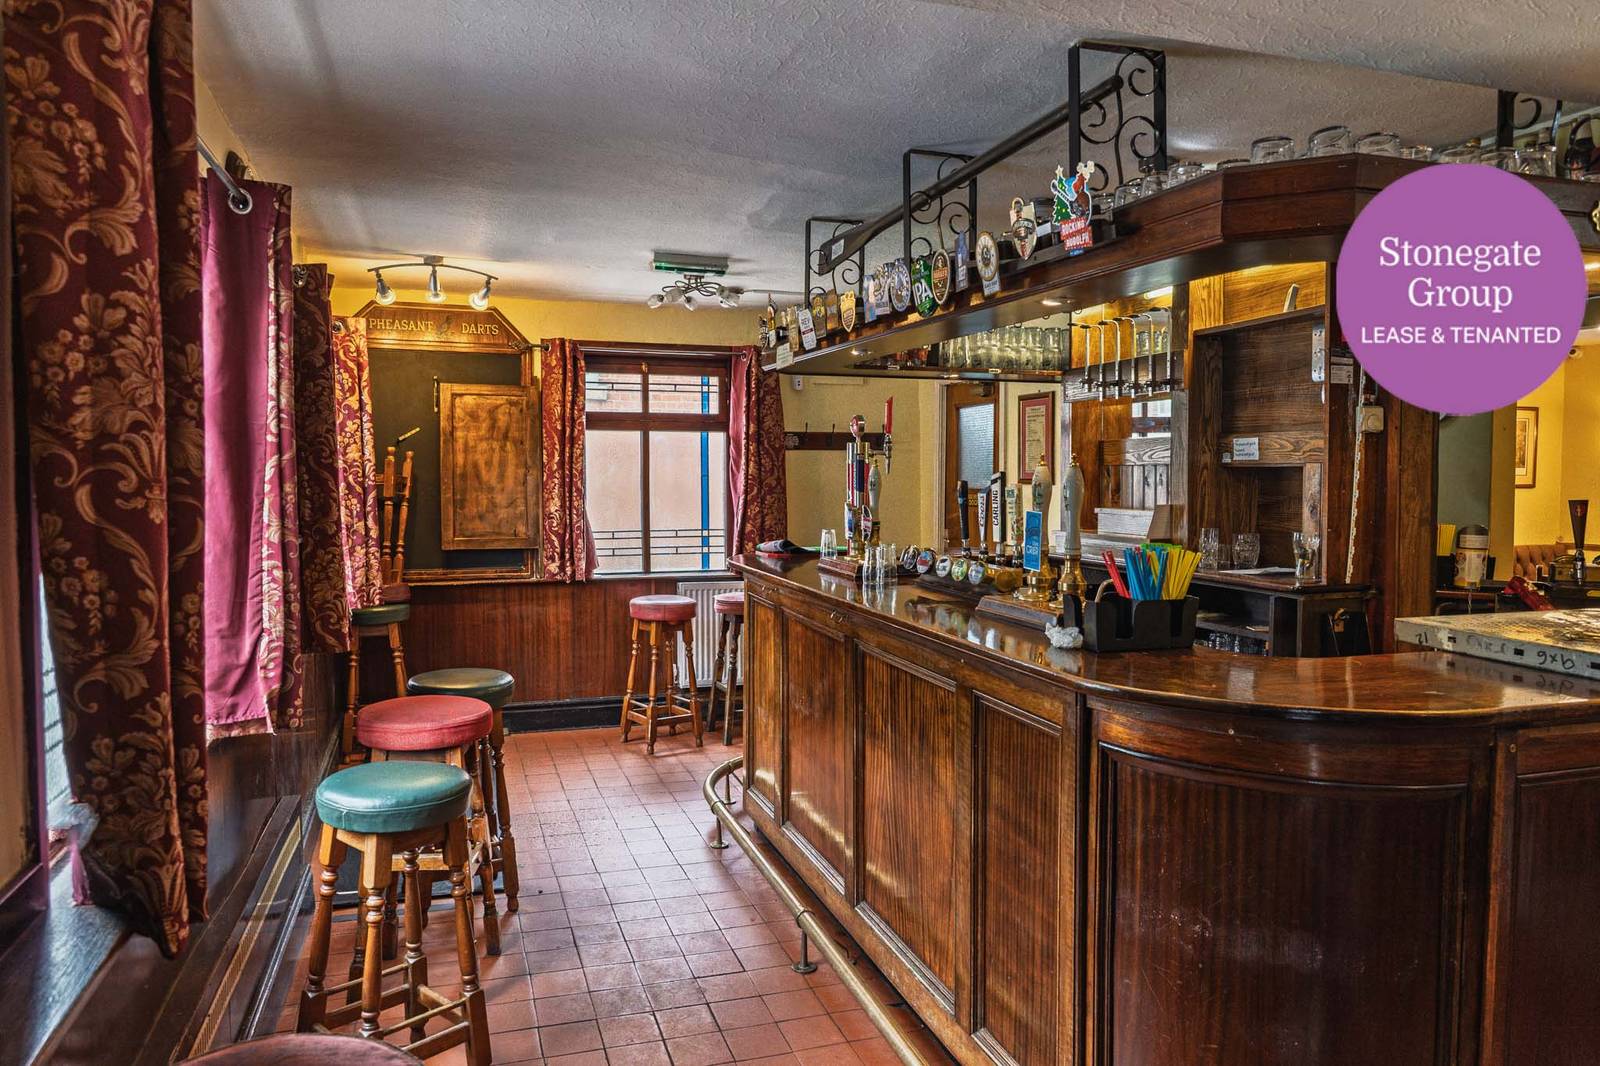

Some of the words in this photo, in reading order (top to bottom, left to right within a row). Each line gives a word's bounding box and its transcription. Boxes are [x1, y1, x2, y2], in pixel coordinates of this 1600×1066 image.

[912, 279, 934, 306] IPA
[369, 318, 433, 331] PHEASANT
[461, 322, 499, 335] DARTS
